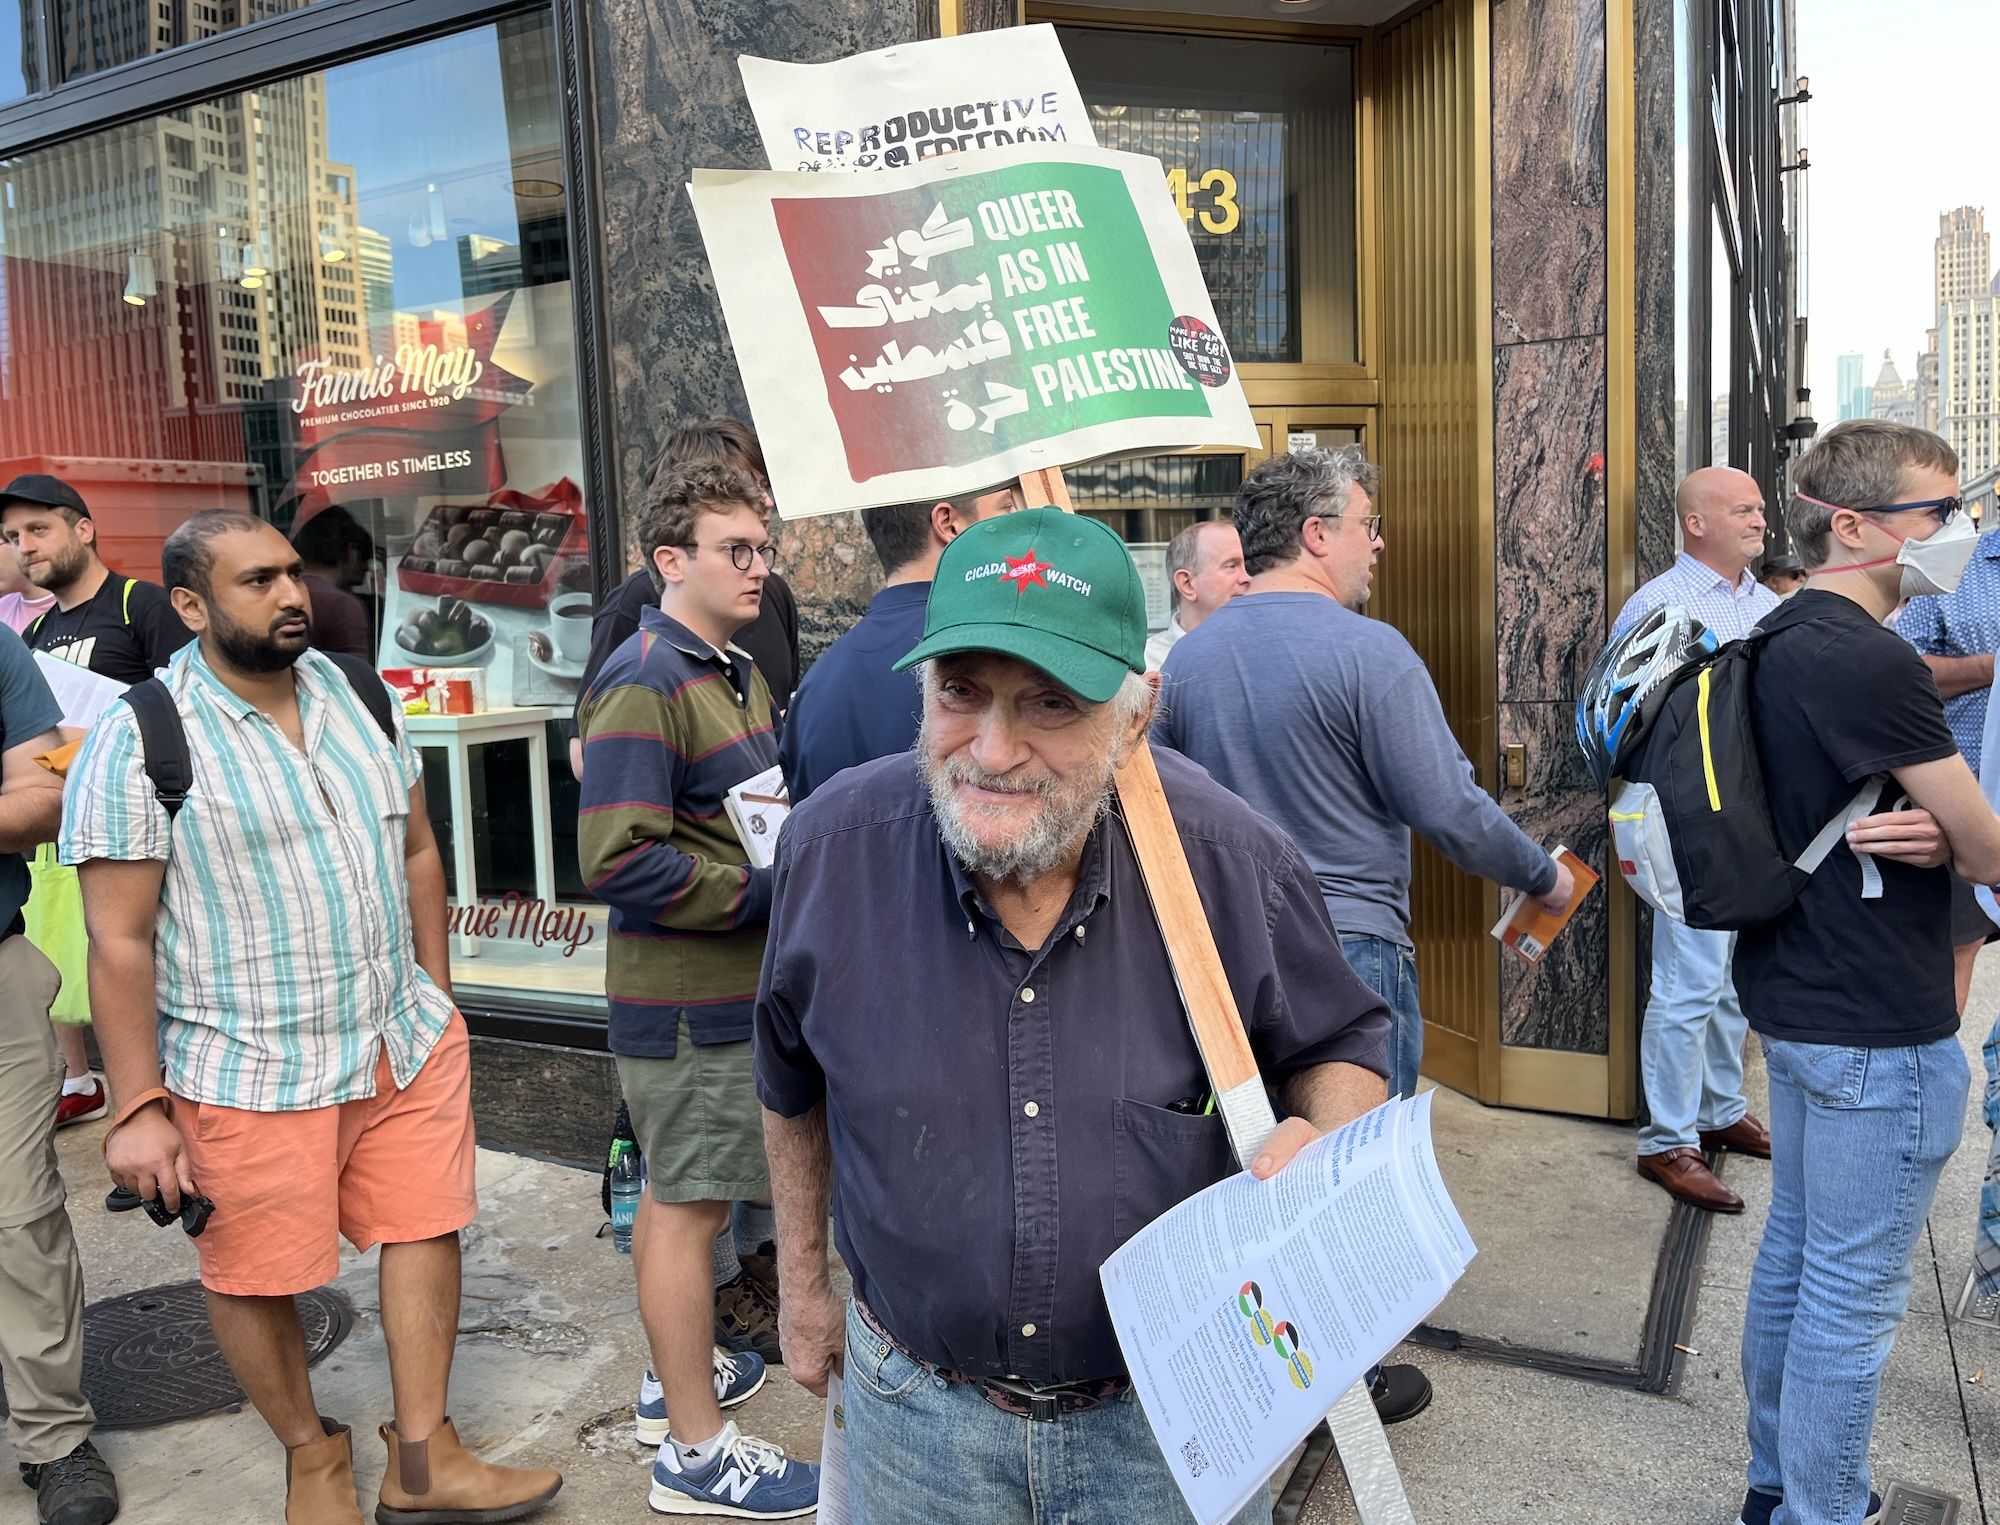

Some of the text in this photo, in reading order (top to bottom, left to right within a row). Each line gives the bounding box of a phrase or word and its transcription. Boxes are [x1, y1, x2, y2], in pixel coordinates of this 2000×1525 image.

[793, 92, 1058, 155] REPRODUCTIVE
[977, 190, 1085, 241] QUEER
[997, 241, 1091, 297] AS IN
[1012, 295, 1097, 351] FREE
[1170, 334, 1198, 352] LIKE
[292, 342, 484, 415] Fannie May
[300, 395, 450, 429] PREMIUM CHOCOLATIER SINCE 1920
[311, 449, 472, 487] TOGETHER IS TIMELESS
[964, 562, 1092, 597] CICADA WATCH
[502, 890, 594, 957] May
[1332, 1153, 1342, 1187] Ukraine
[1237, 1361, 1255, 1392] Chicago
[1253, 1394, 1266, 1414] Sept
[710, 1466, 761, 1504] N
